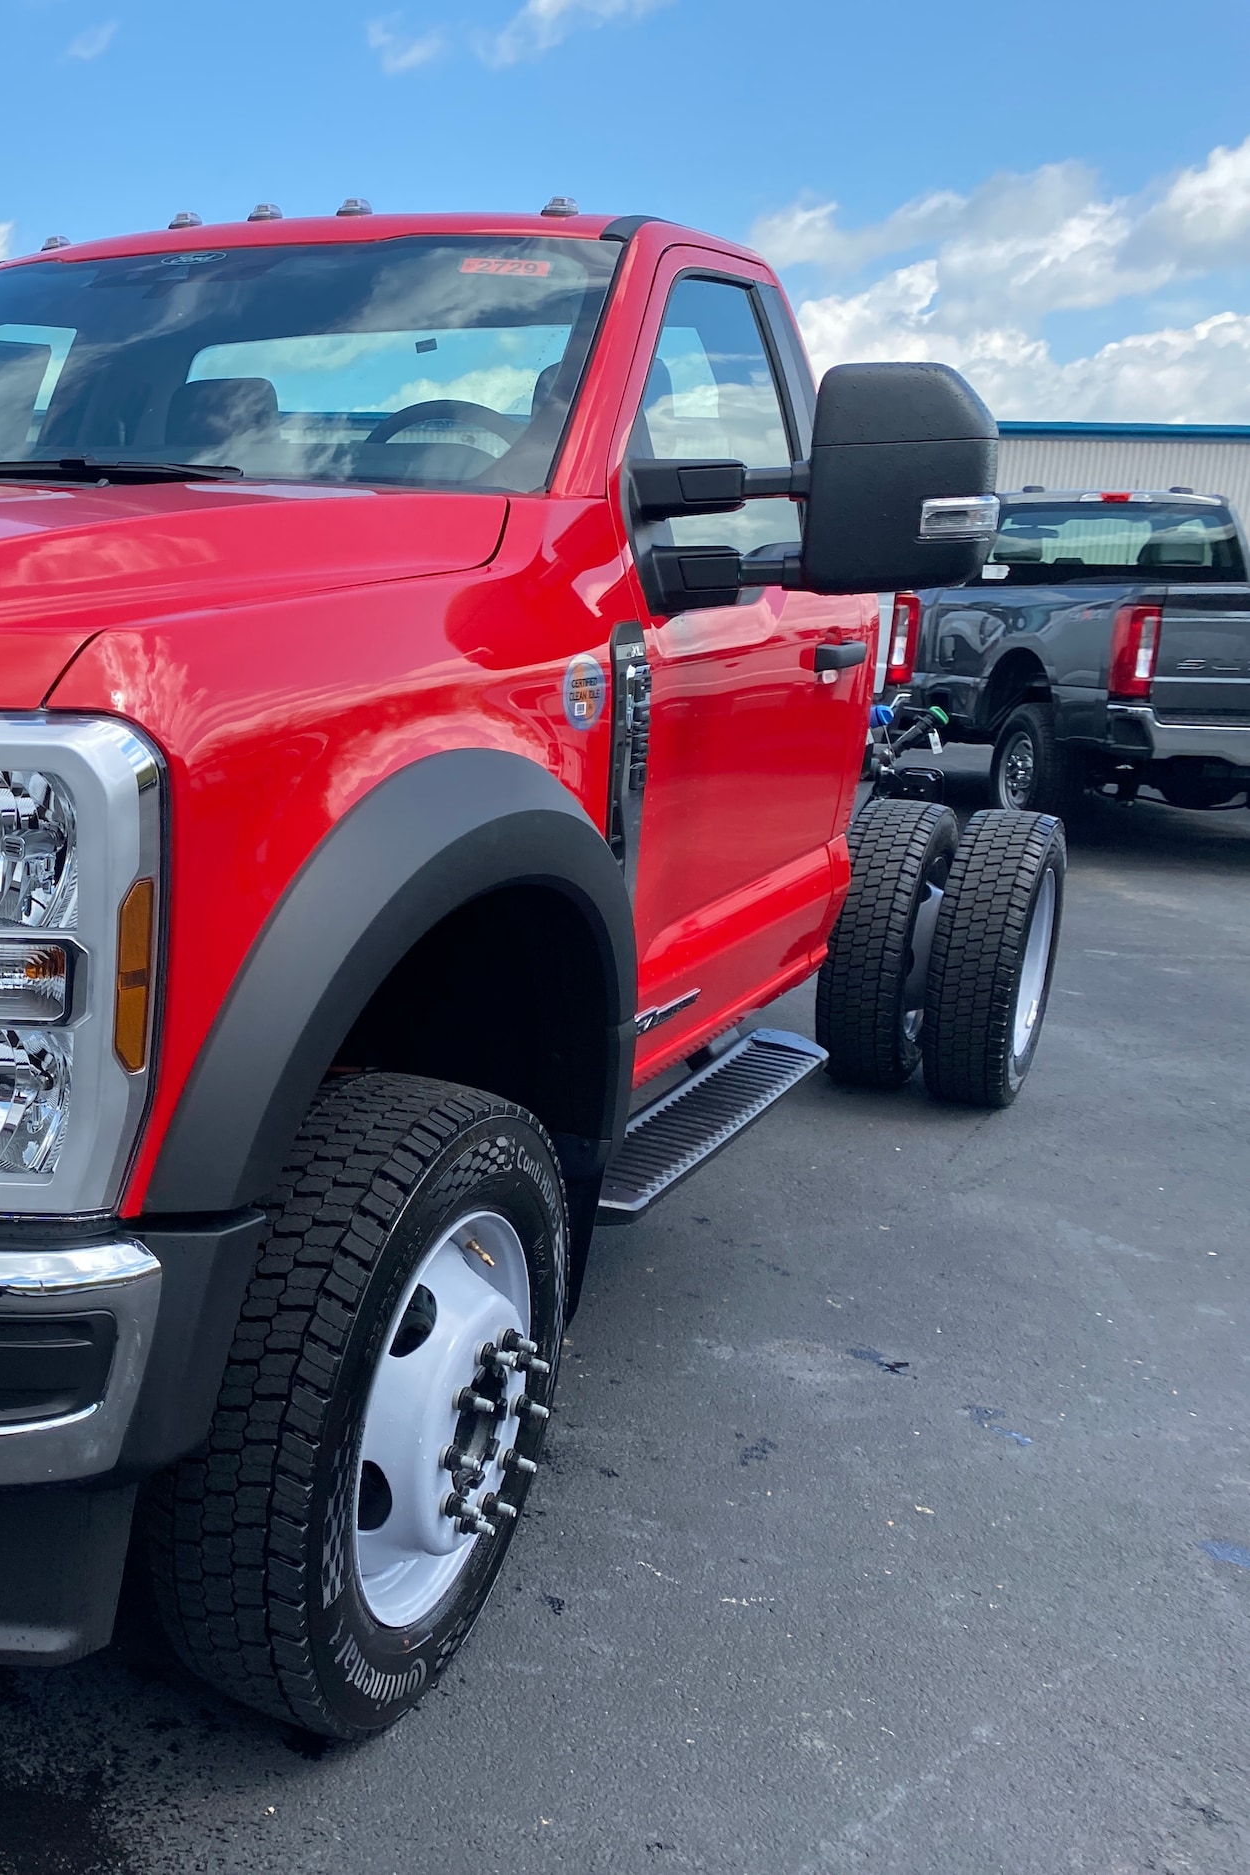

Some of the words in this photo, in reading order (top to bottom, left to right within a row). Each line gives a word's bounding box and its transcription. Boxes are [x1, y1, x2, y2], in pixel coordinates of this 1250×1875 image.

[477, 261, 538, 274] 2729
[571, 677, 598, 688] CERTIFIED
[569, 690, 587, 701] CLEAN
[588, 689, 600, 699] IDLE
[517, 1145, 543, 1185] Conti
[334, 1633, 427, 1711] Continental
